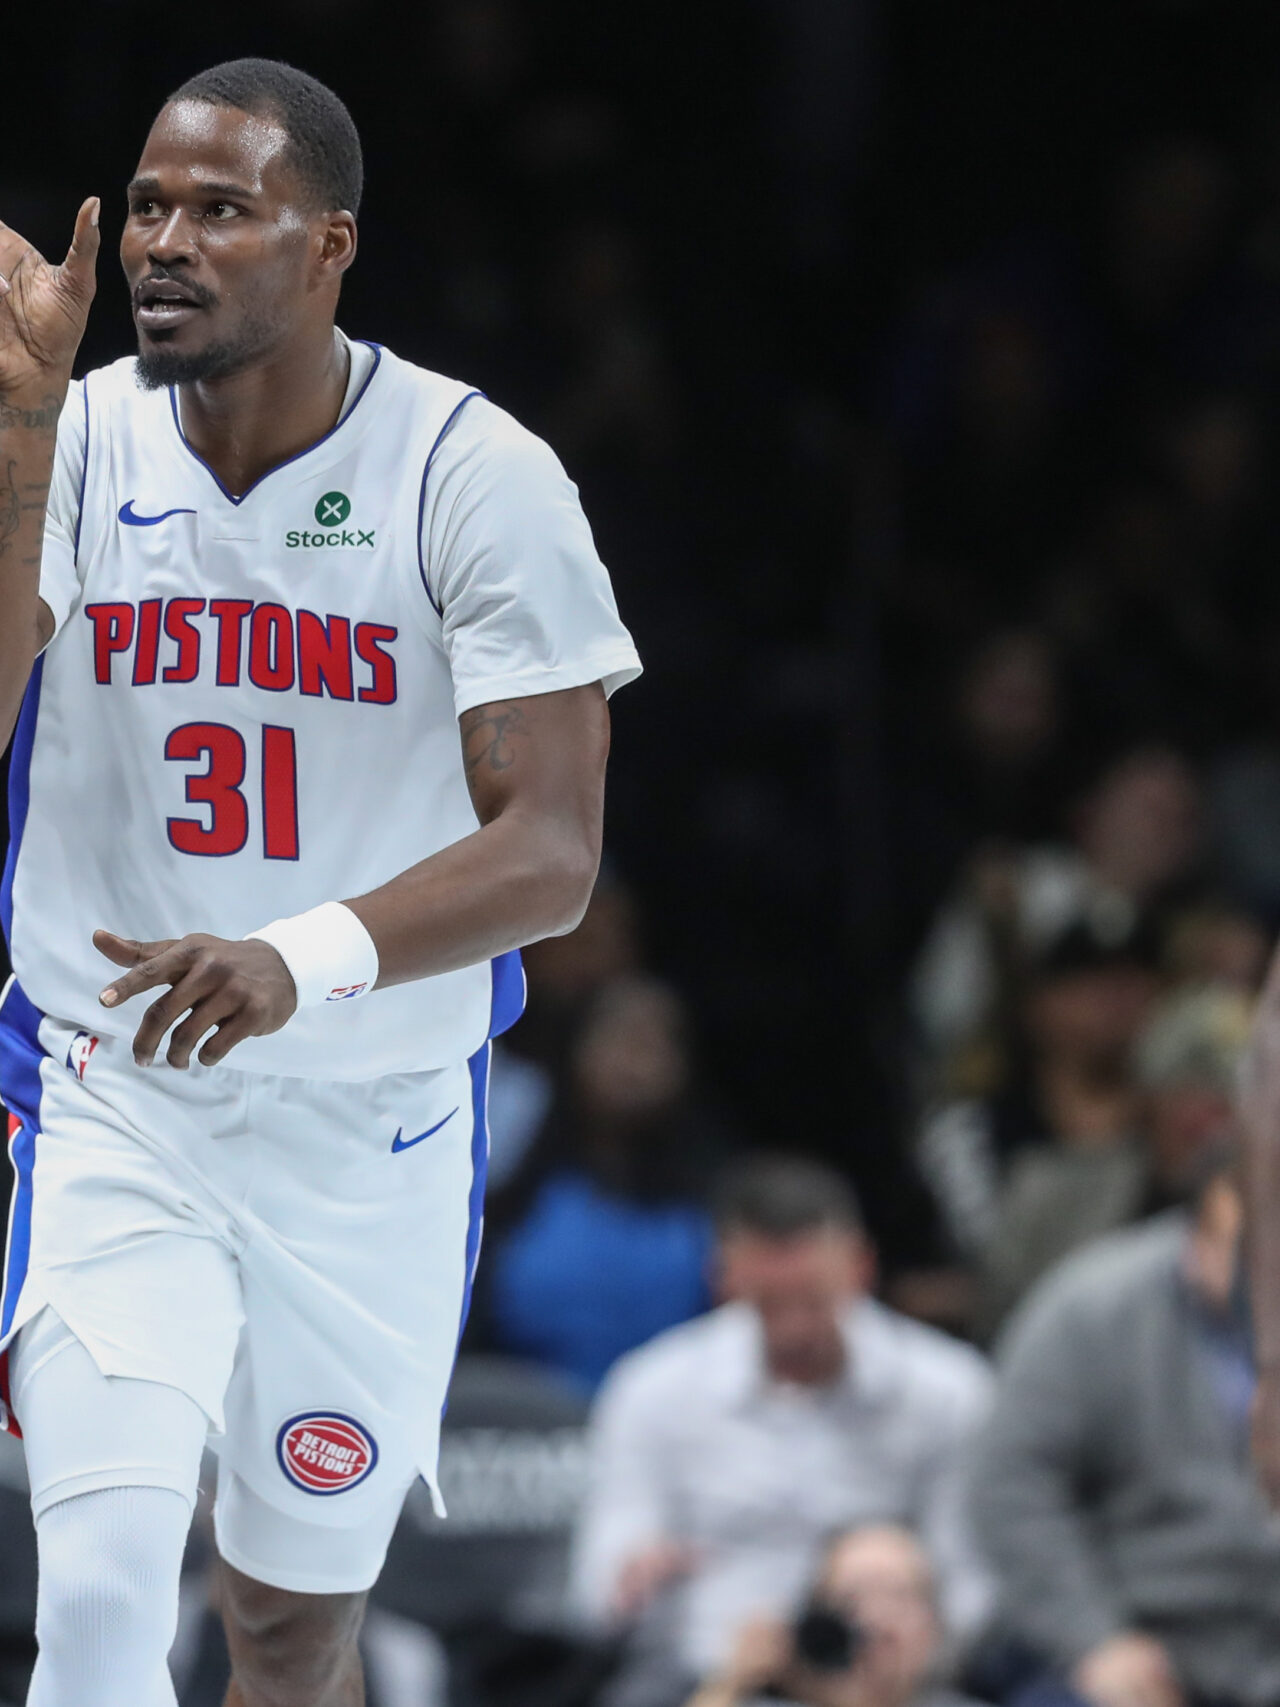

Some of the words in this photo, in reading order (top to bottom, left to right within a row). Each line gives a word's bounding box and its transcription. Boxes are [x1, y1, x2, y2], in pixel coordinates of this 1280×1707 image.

[285, 529, 375, 548] StockX
[84, 597, 398, 706] PISTONS
[164, 721, 300, 861] 31
[293, 1442, 355, 1475] PISTONS
[301, 1430, 361, 1463] DETROIT
